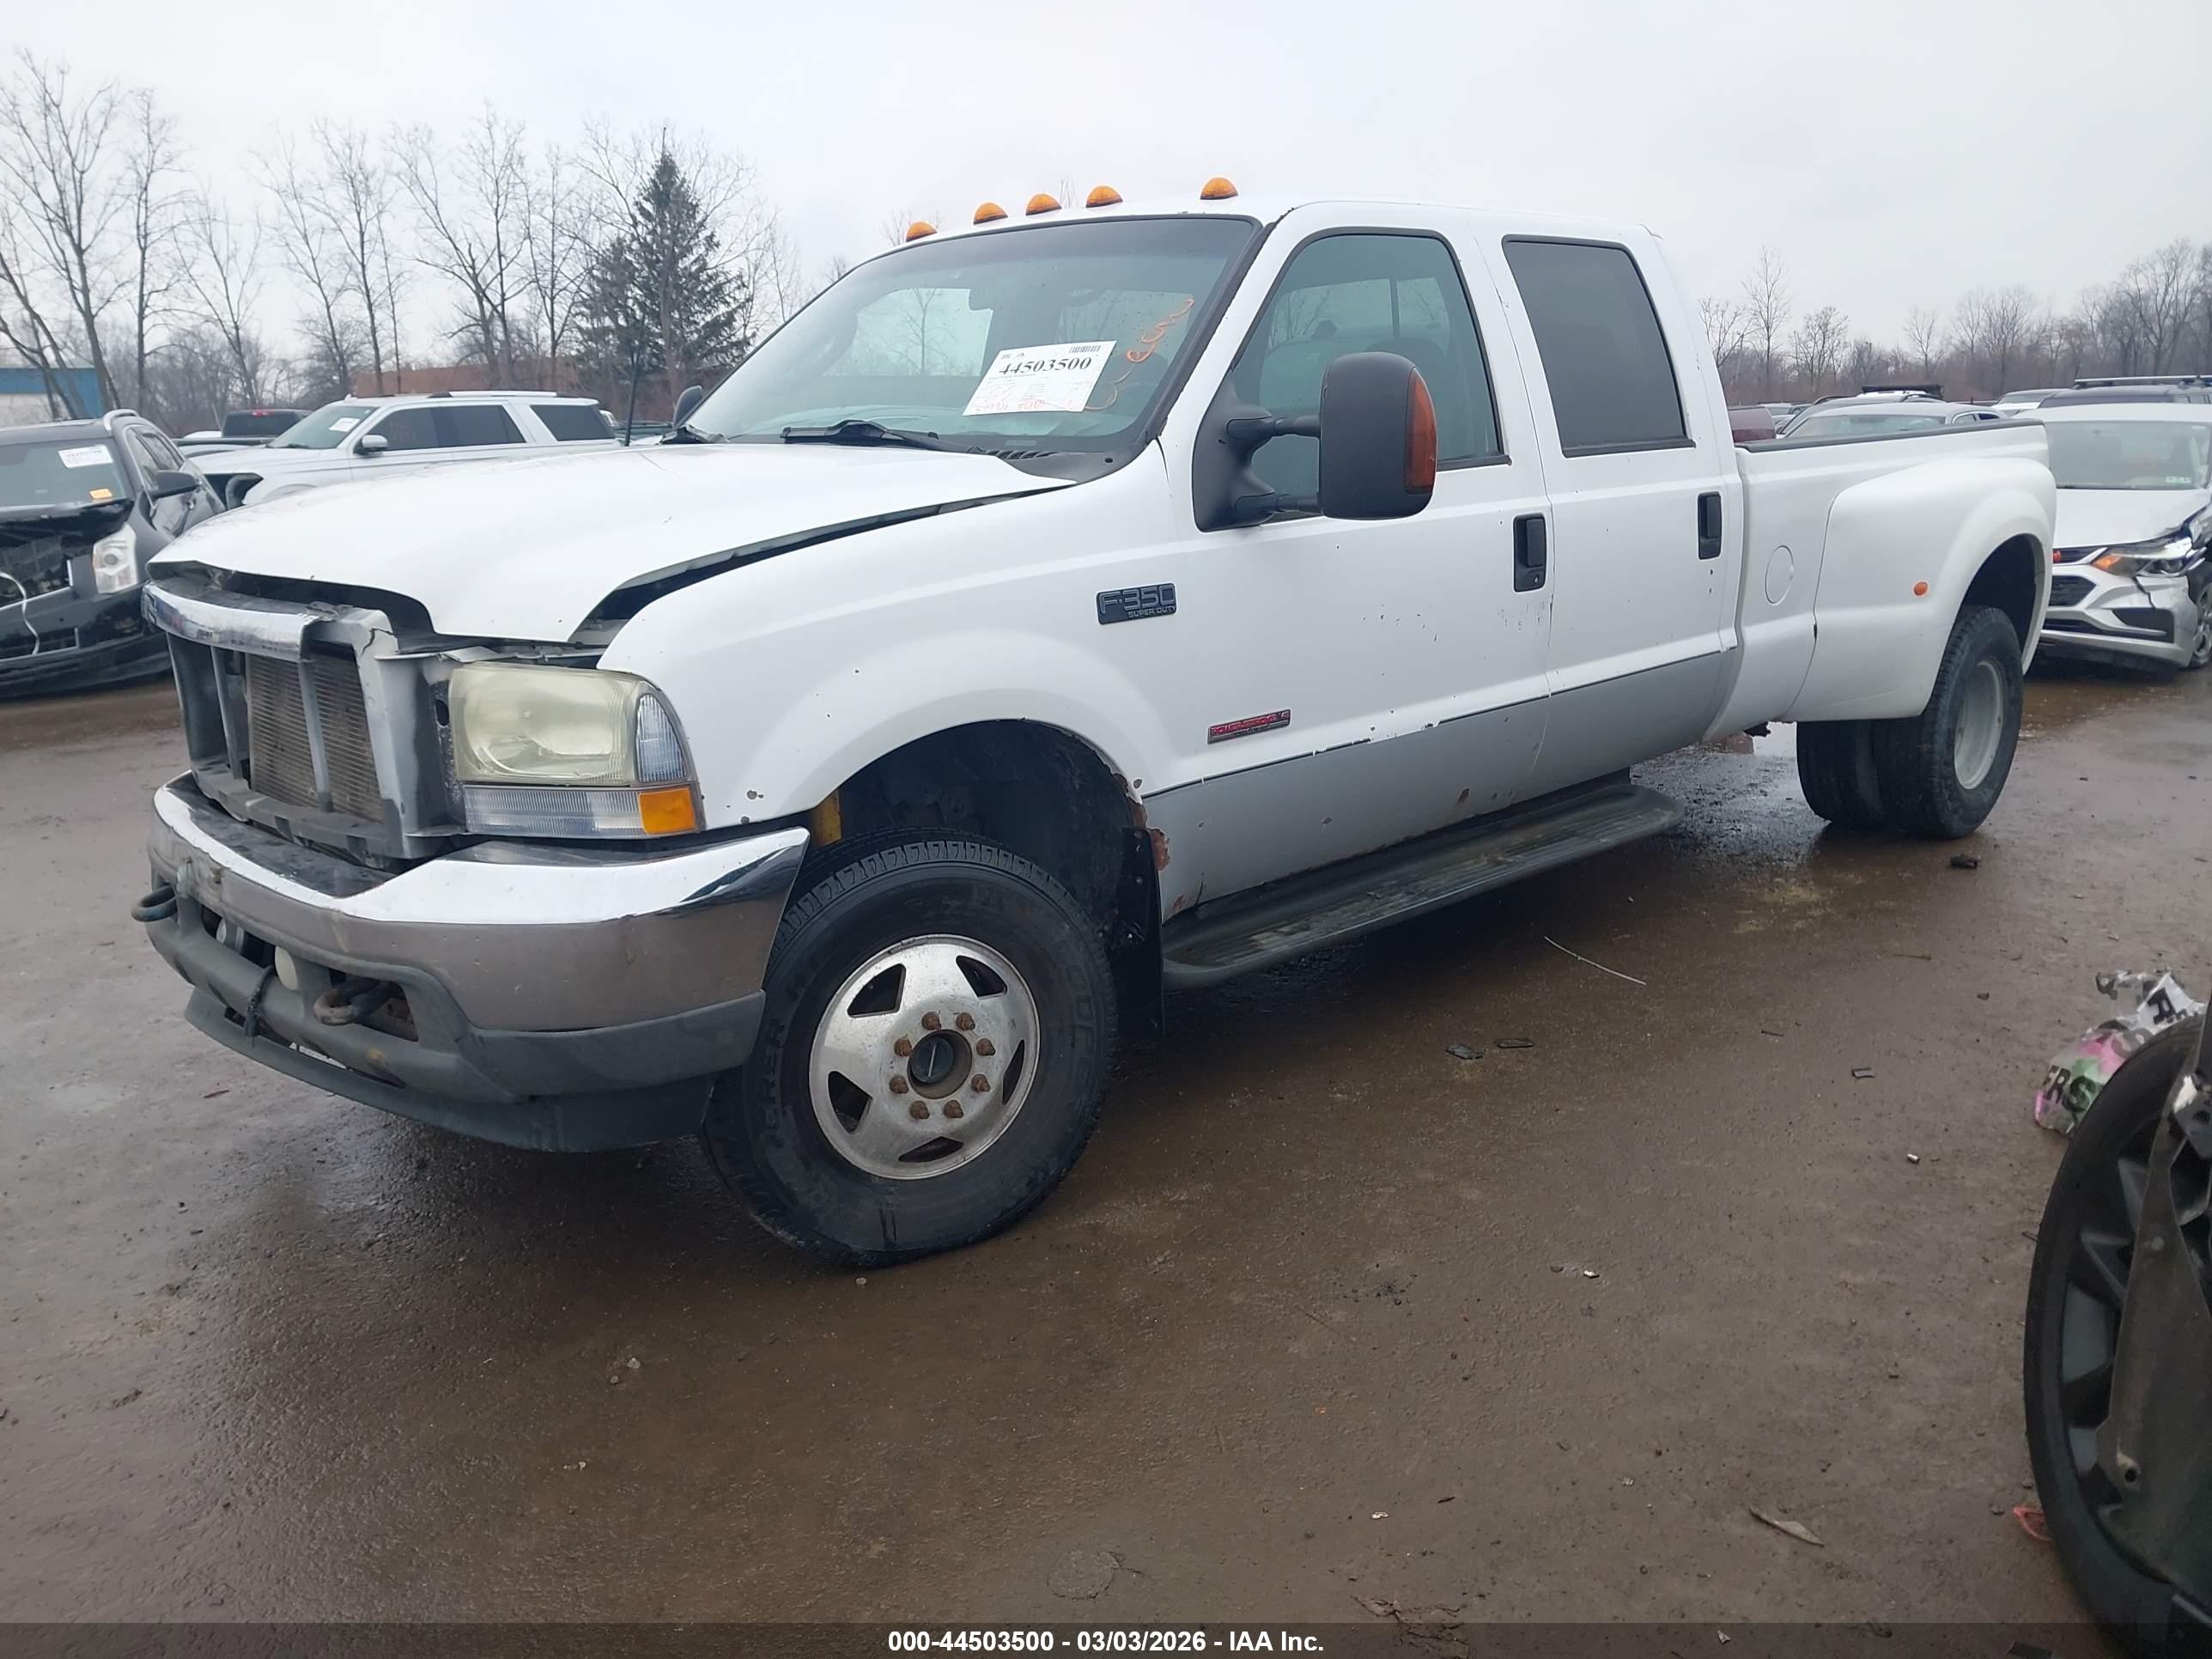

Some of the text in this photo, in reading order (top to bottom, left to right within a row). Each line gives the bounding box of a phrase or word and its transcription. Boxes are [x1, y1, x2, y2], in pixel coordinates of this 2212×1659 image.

[999, 356, 1091, 374] 44503500
[1127, 605, 1176, 618] SUPER DUTY
